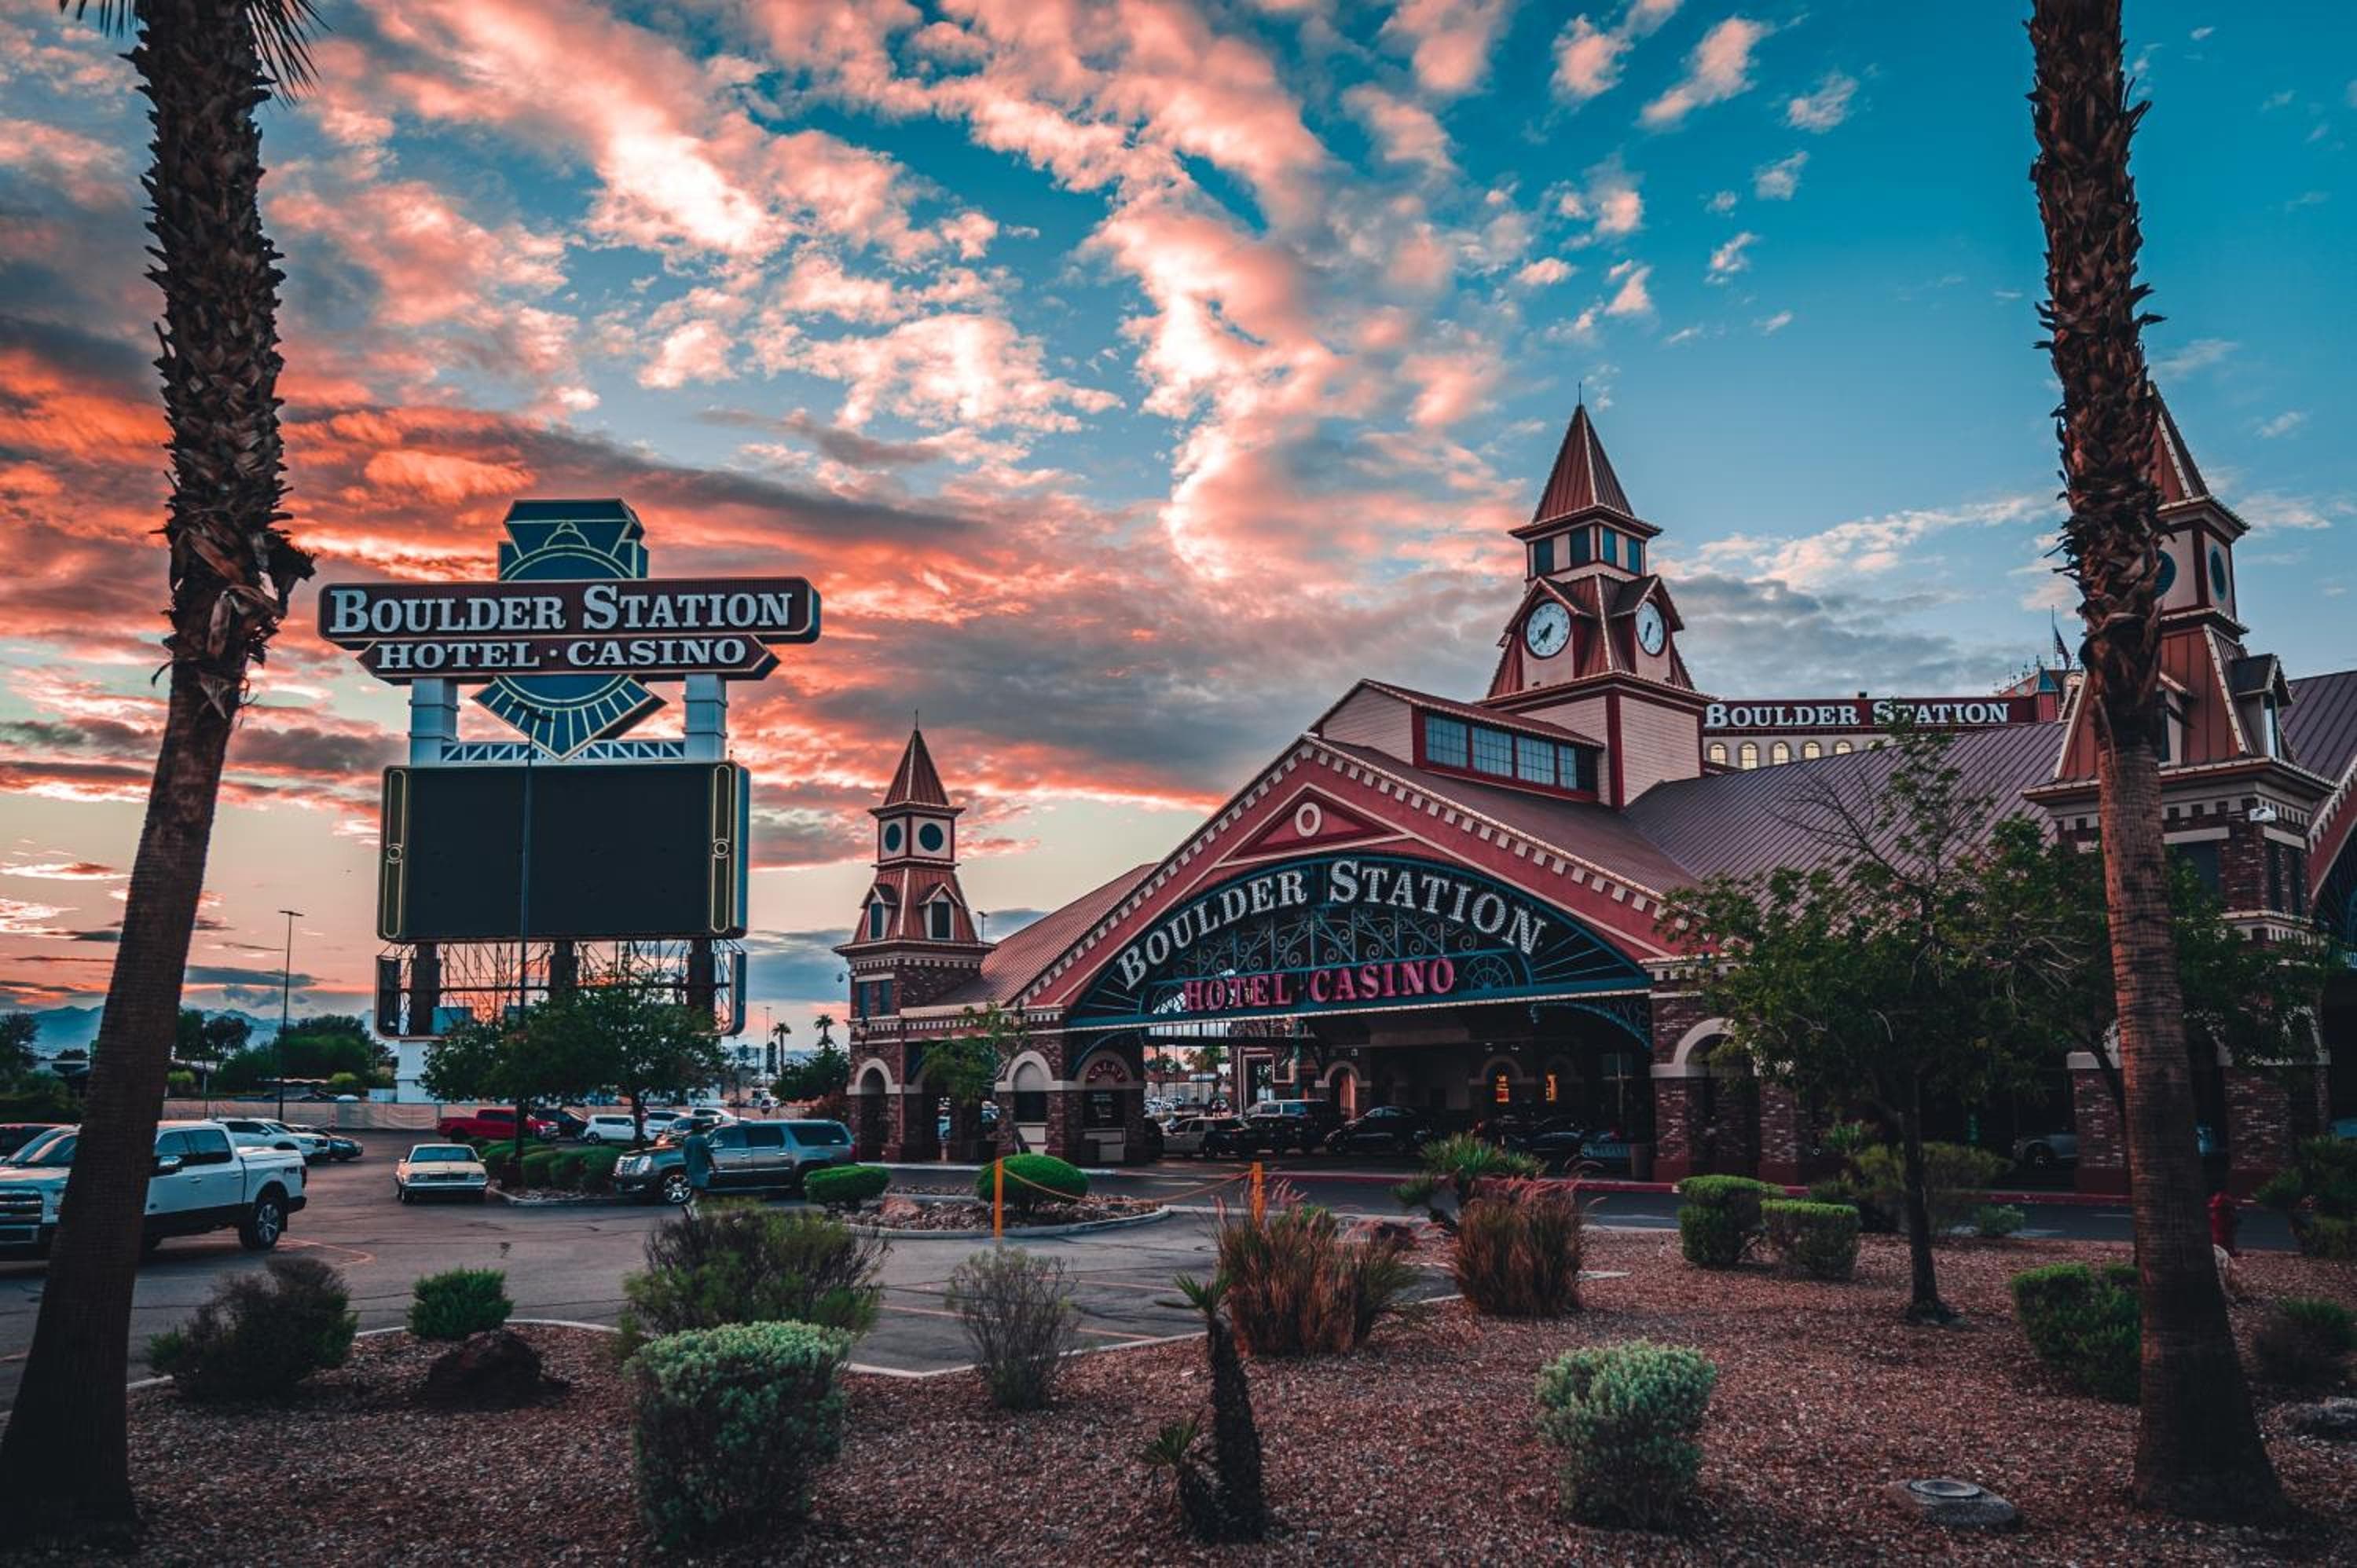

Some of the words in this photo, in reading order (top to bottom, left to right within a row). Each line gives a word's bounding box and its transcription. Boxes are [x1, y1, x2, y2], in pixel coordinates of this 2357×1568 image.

[328, 590, 566, 633] BOULDER
[583, 585, 793, 630] STATION
[376, 641, 541, 669] HOTEL
[566, 639, 746, 666] CASINO
[1703, 703, 1860, 729] BOULDER
[1116, 870, 1307, 991] BOULDER
[1329, 859, 1547, 955] STATION
[1184, 973, 1293, 1011] HOTEL
[1309, 958, 1455, 1003] CASINO
